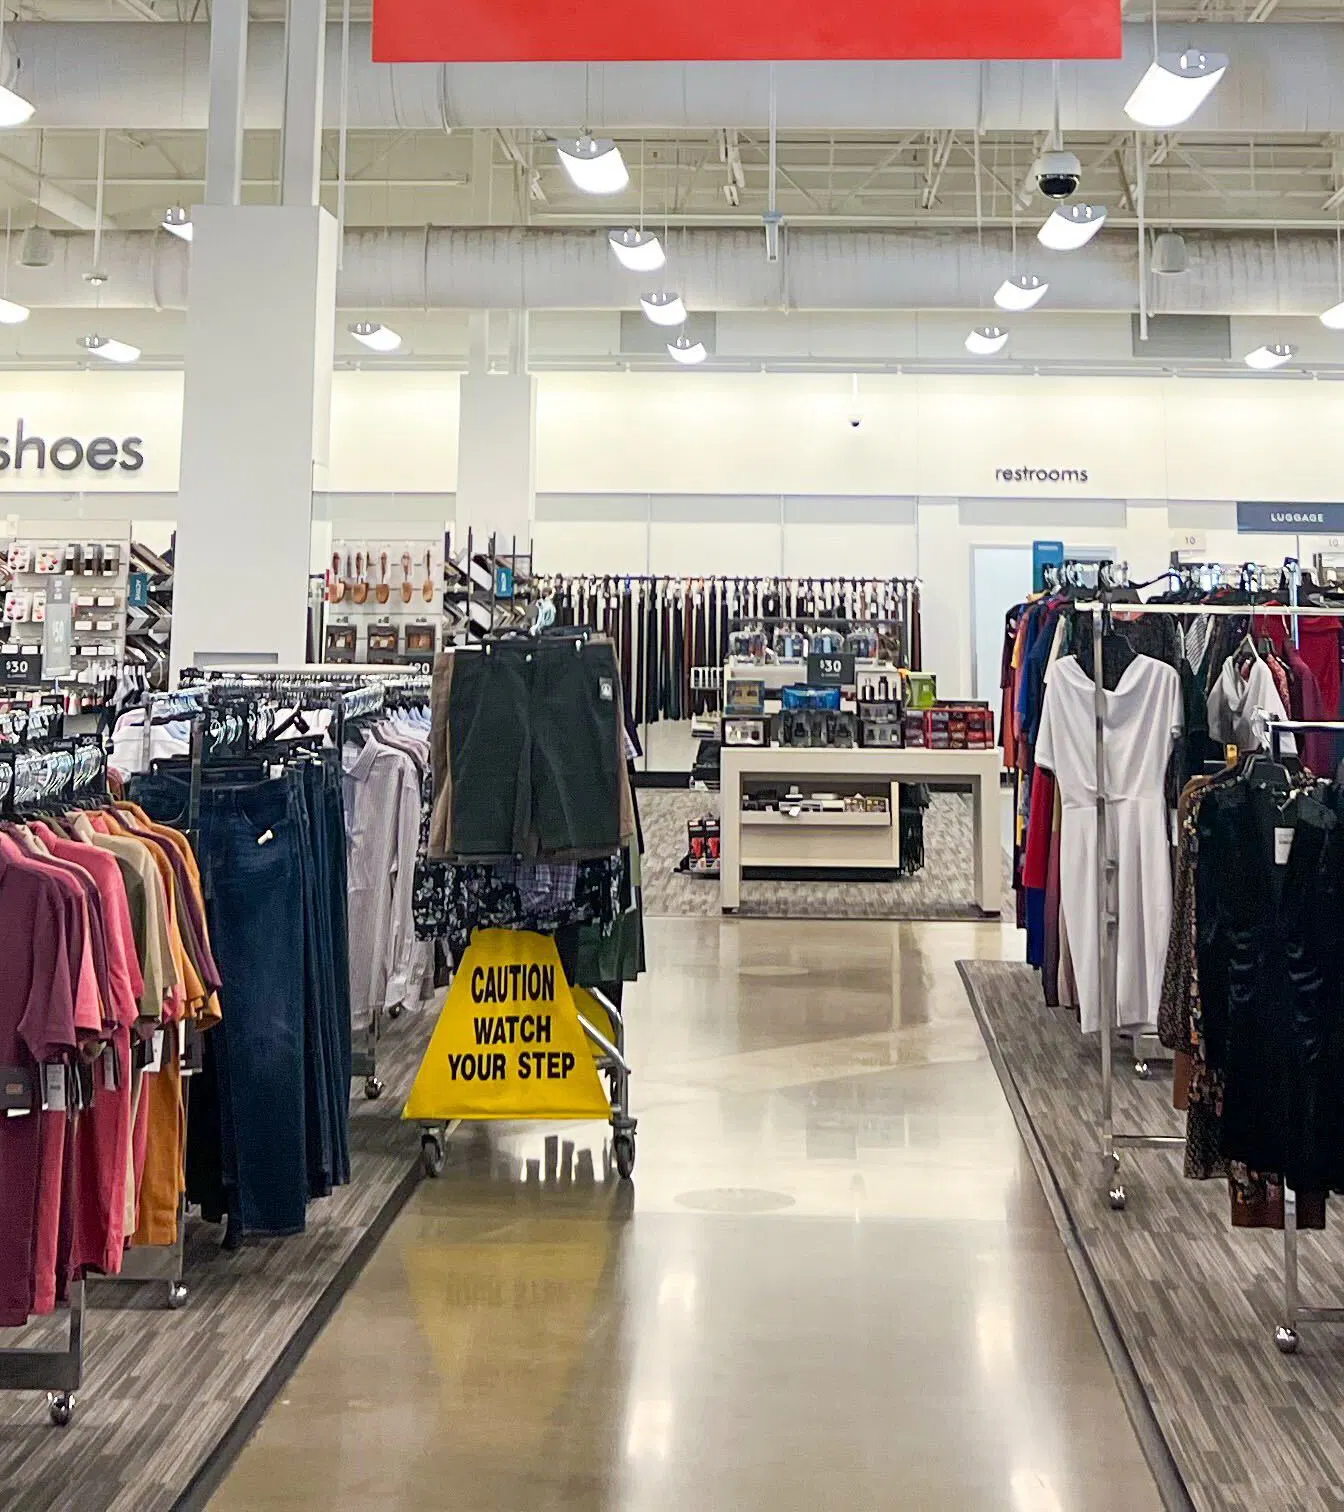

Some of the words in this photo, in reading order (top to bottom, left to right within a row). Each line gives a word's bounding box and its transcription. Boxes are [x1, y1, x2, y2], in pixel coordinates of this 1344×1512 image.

[995, 466, 1089, 482] restrooms
[1270, 512, 1325, 523] LUGGAGE
[1185, 536, 1196, 545] 10
[6, 660, 28, 673] $30
[409, 662, 430, 675] 20
[820, 659, 842, 672] $30
[471, 963, 555, 1003] CAUTION
[474, 1015, 552, 1045] WATCH
[448, 1053, 507, 1081] YOUR
[518, 1051, 575, 1080] STEP
